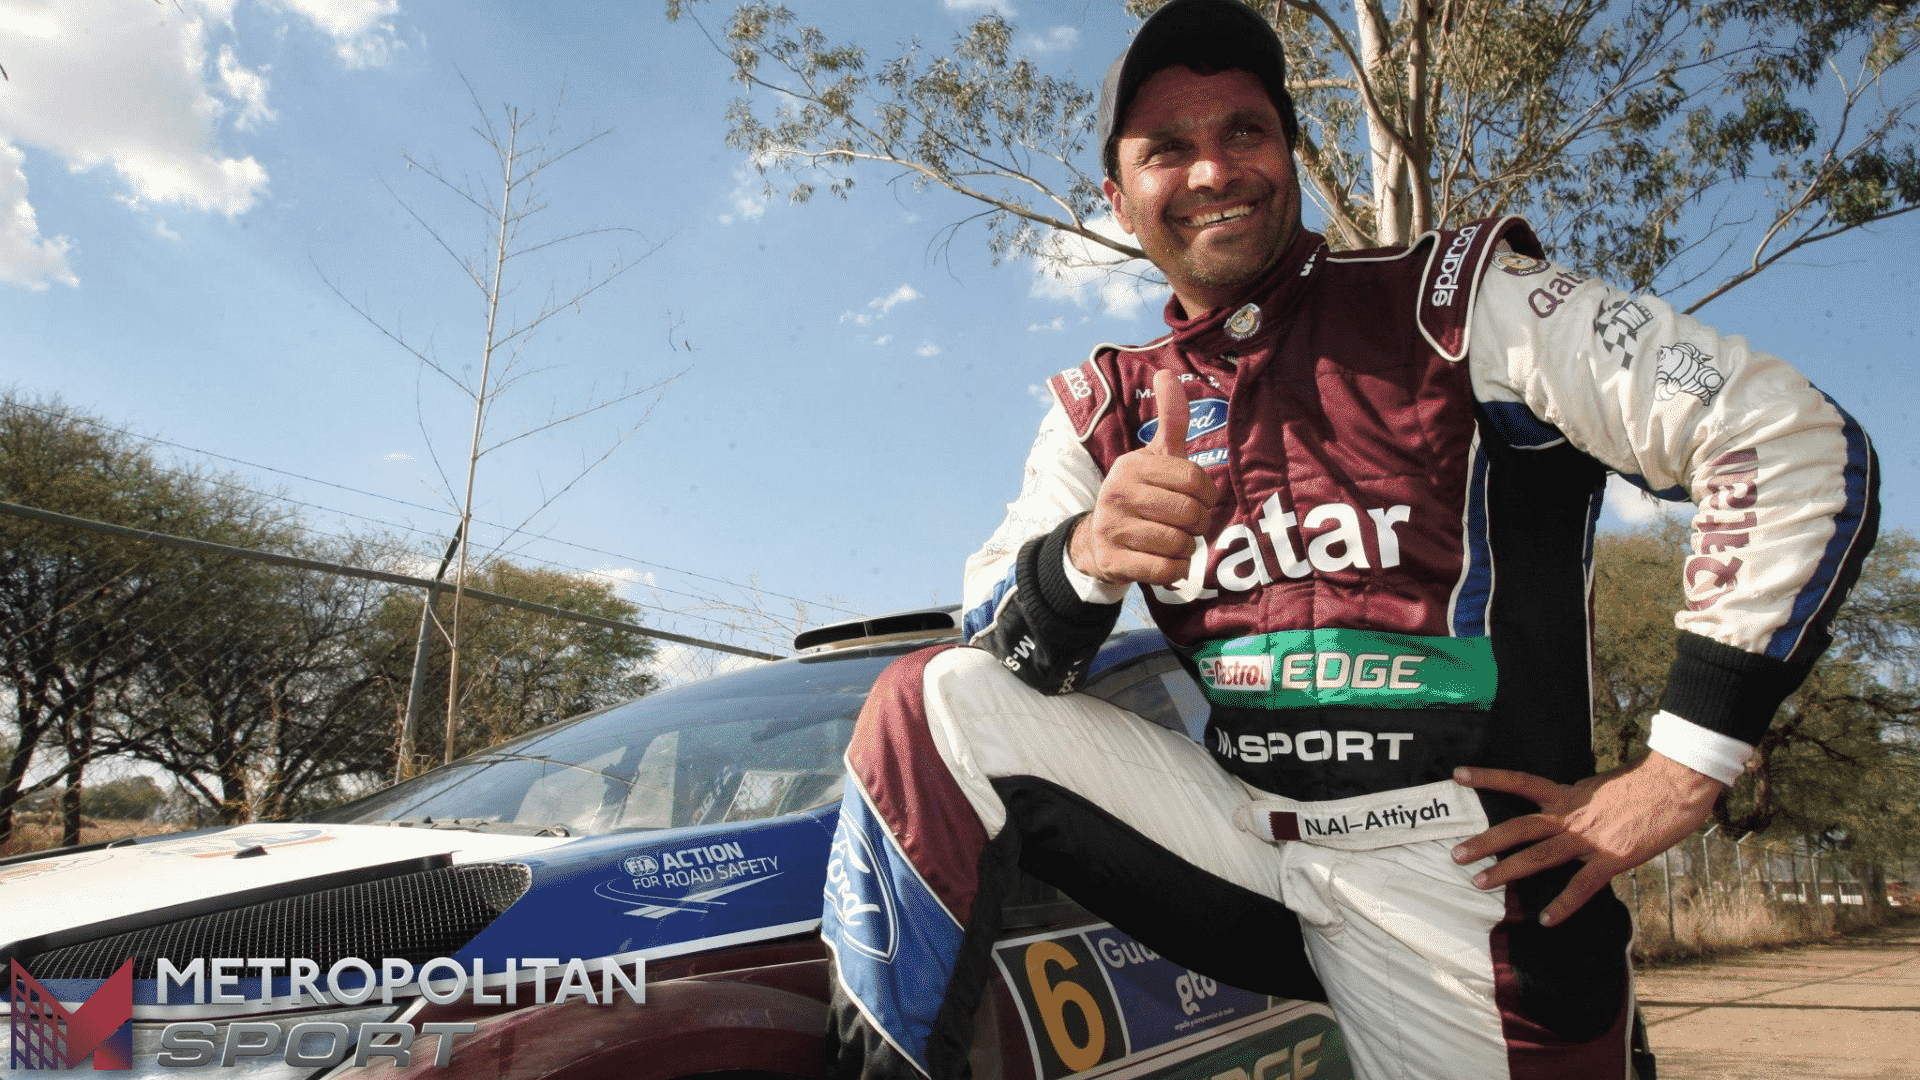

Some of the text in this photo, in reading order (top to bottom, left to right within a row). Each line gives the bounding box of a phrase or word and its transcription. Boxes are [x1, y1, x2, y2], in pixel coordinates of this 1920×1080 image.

[1432, 224, 1482, 307] sparco
[1528, 271, 1584, 319] Qat
[1281, 651, 1427, 691] EDGE
[632, 856, 778, 890] FOR ROAD SAFETY
[662, 842, 744, 871] ACTION
[1025, 941, 1105, 1073] 6
